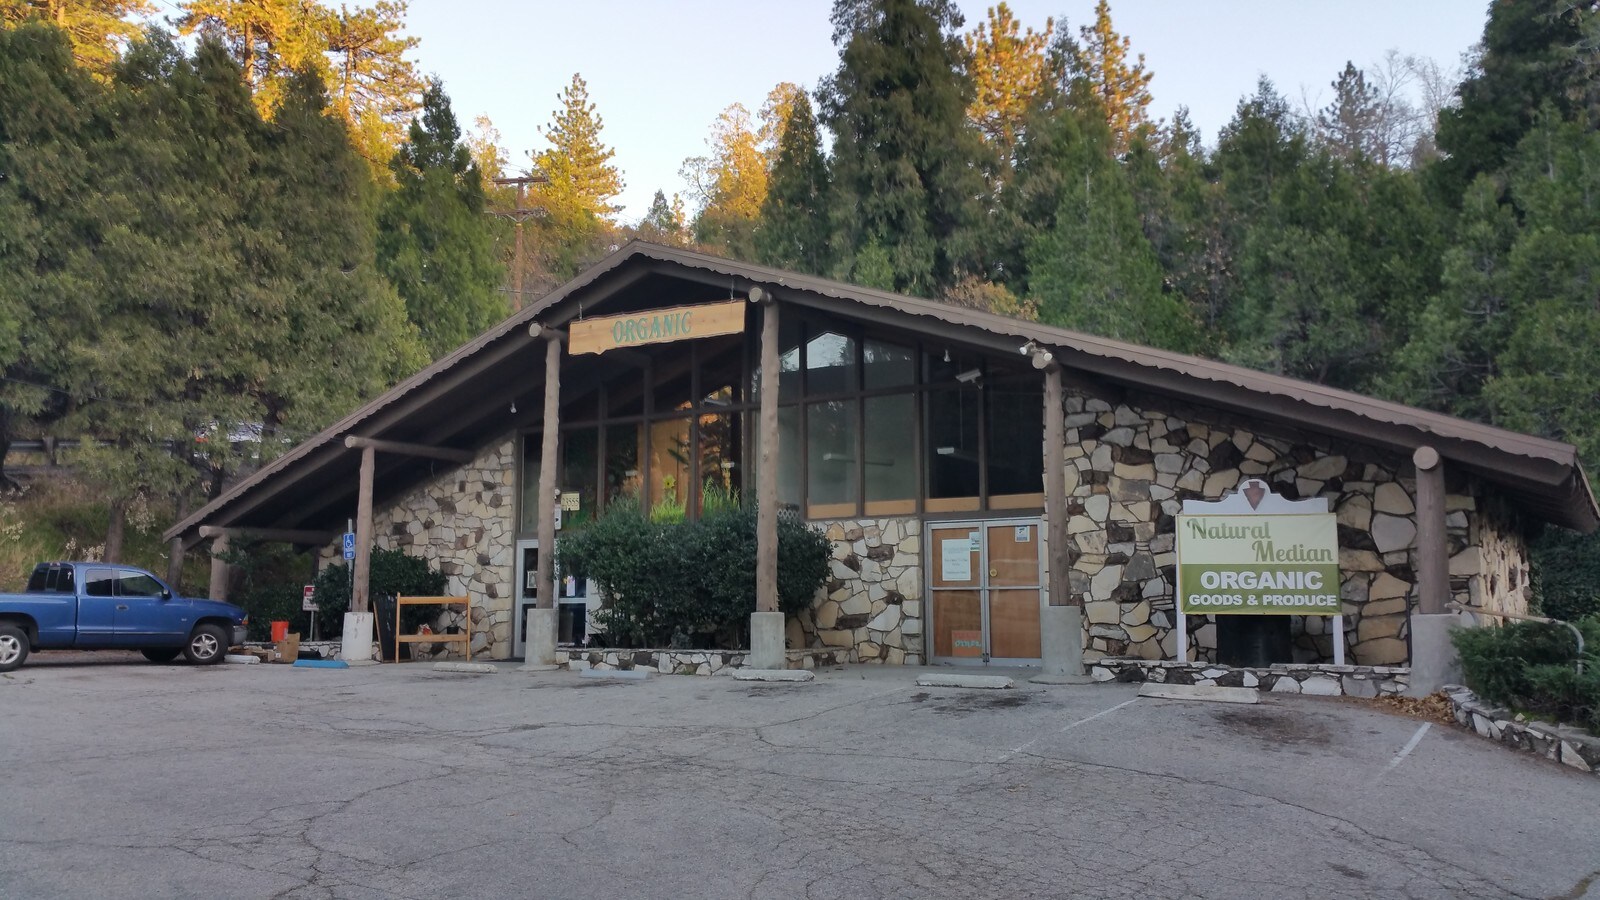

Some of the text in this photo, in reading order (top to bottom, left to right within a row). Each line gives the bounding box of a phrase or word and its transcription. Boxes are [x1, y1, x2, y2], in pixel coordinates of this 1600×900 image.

[612, 311, 693, 344] ORGANIC
[1186, 517, 1271, 540] Natural
[1251, 540, 1333, 562] Median
[1200, 571, 1324, 590] ORGANIC
[1188, 594, 1337, 606] GOODS & PRODUCE
